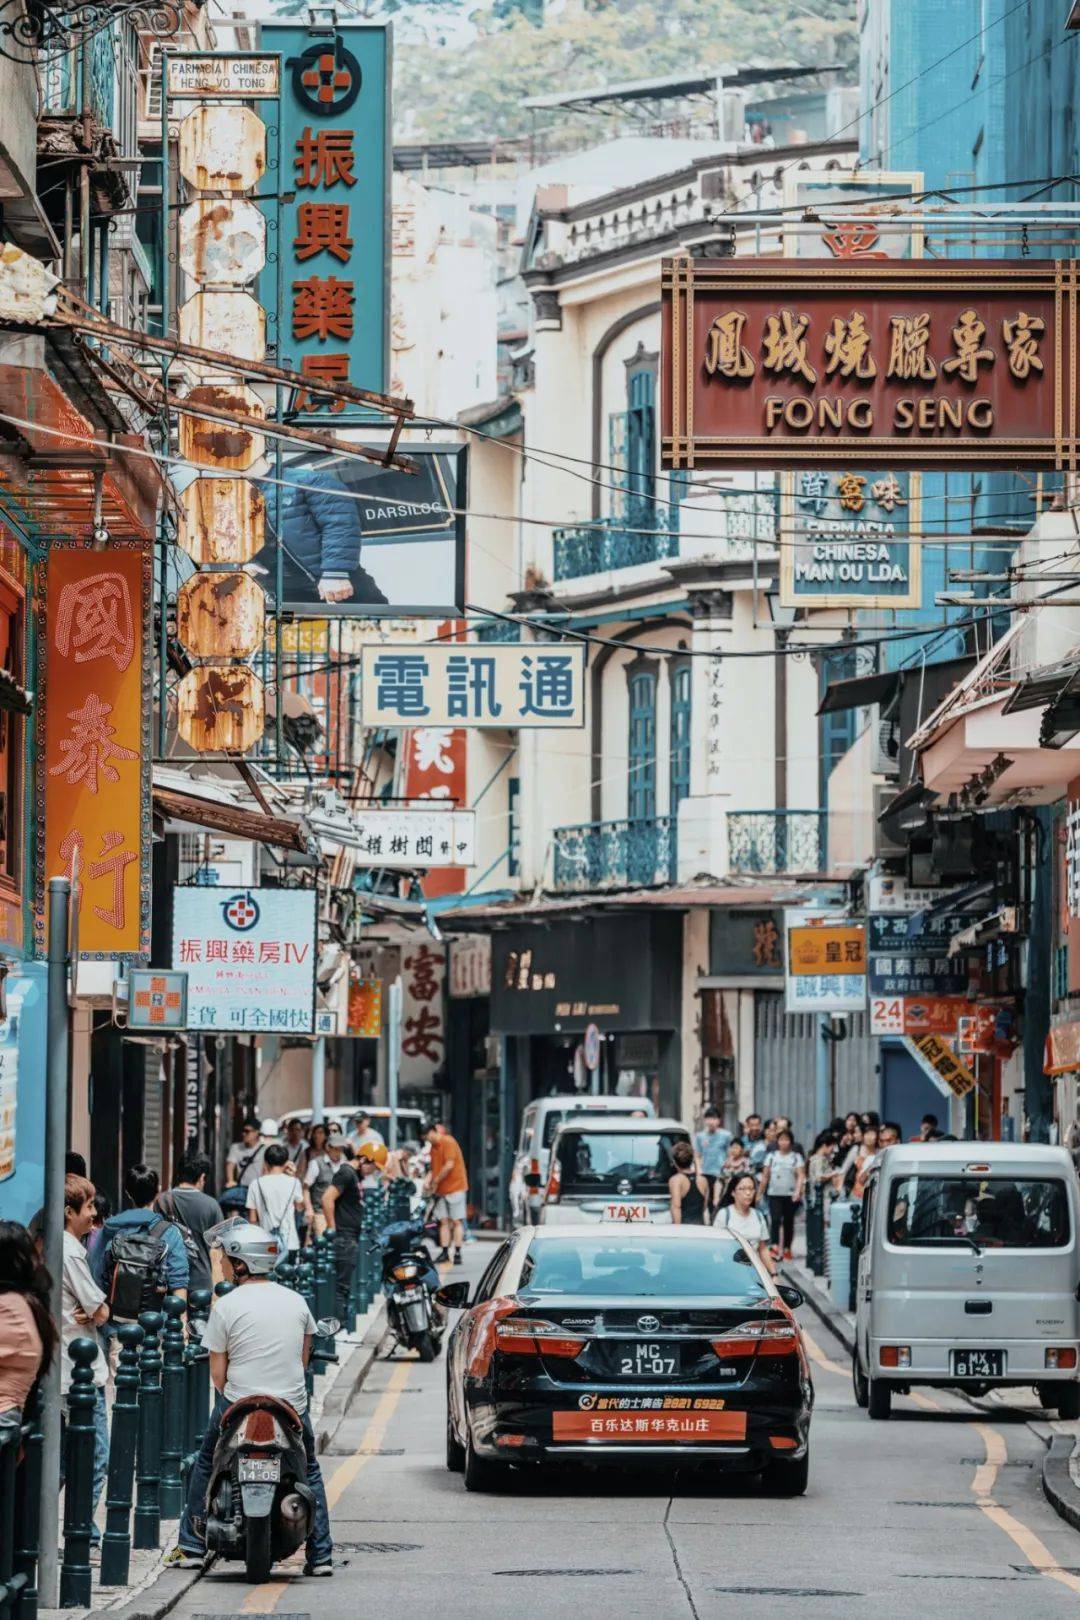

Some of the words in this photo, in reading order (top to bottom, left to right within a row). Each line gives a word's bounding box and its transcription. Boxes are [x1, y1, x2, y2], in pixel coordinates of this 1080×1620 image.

[171, 63, 222, 74] FARMACIA
[232, 63, 275, 74] CHINESA
[181, 77, 208, 88] HENG
[239, 78, 266, 88] TONG
[765, 397, 874, 429] FONG
[895, 397, 994, 429] SENG
[806, 522, 895, 540] FARMACIA
[814, 544, 890, 561] CHINESA
[796, 563, 835, 581] MAN
[839, 563, 864, 581] OU
[868, 564, 908, 582] LDA.
[373, 654, 576, 717] 電訊通
[402, 944, 445, 1063] 富安
[874, 1001, 902, 1020] 24
[607, 1206, 647, 1219] TAXI
[636, 1344, 660, 1359] MC
[969, 1352, 987, 1364] MX
[621, 1358, 675, 1374] 21-07
[957, 1363, 998, 1375] 81-41
[590, 1418, 710, 1433] 百乐达斯华克山庄
[242, 1470, 278, 1481] 14-05
